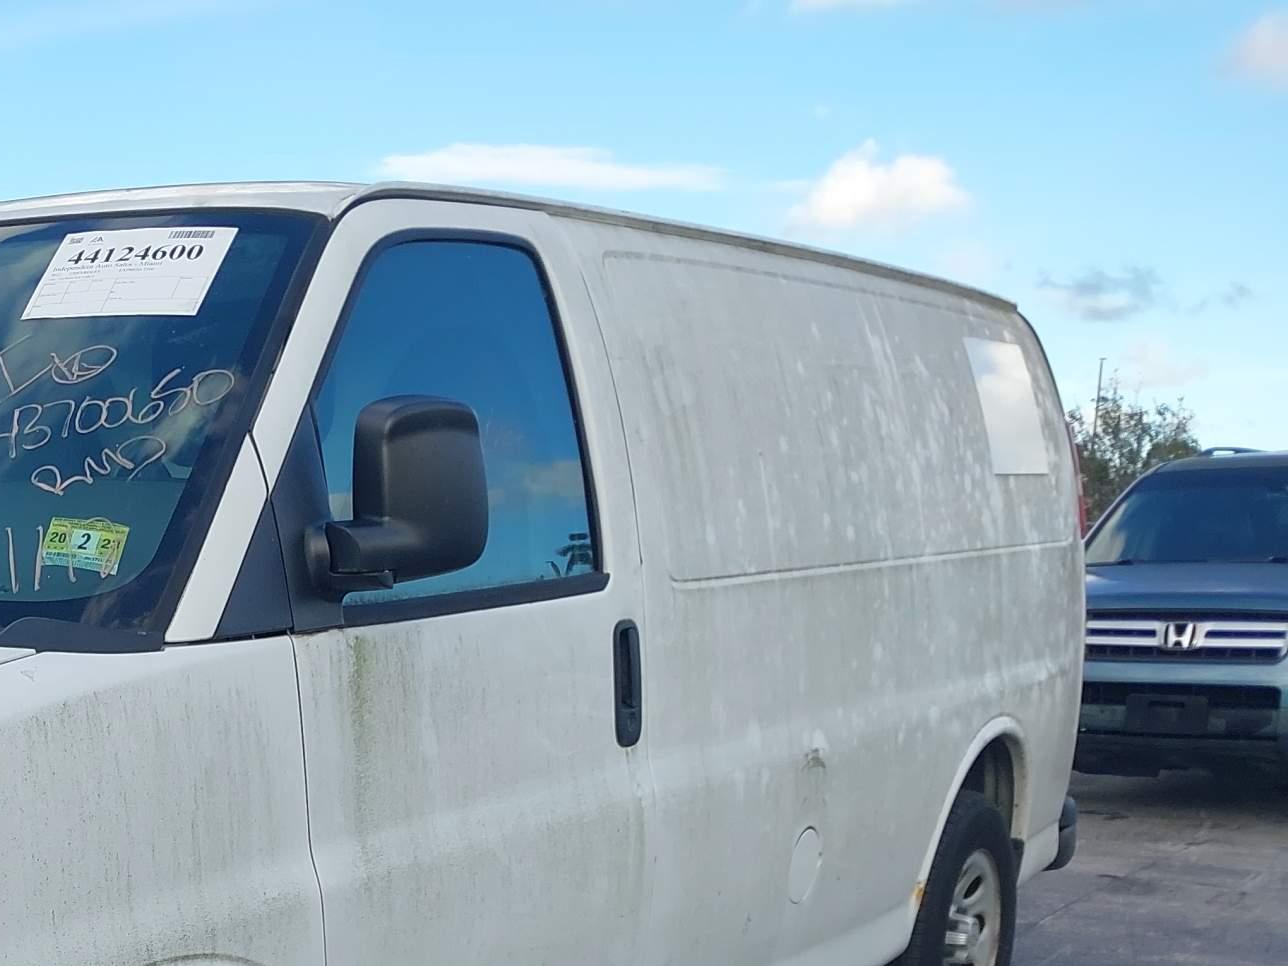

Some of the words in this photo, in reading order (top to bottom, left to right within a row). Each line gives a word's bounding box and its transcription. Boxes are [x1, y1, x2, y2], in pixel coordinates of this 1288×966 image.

[67, 244, 205, 265] 44124600
[49, 531, 67, 544] 20
[76, 532, 92, 551] 2
